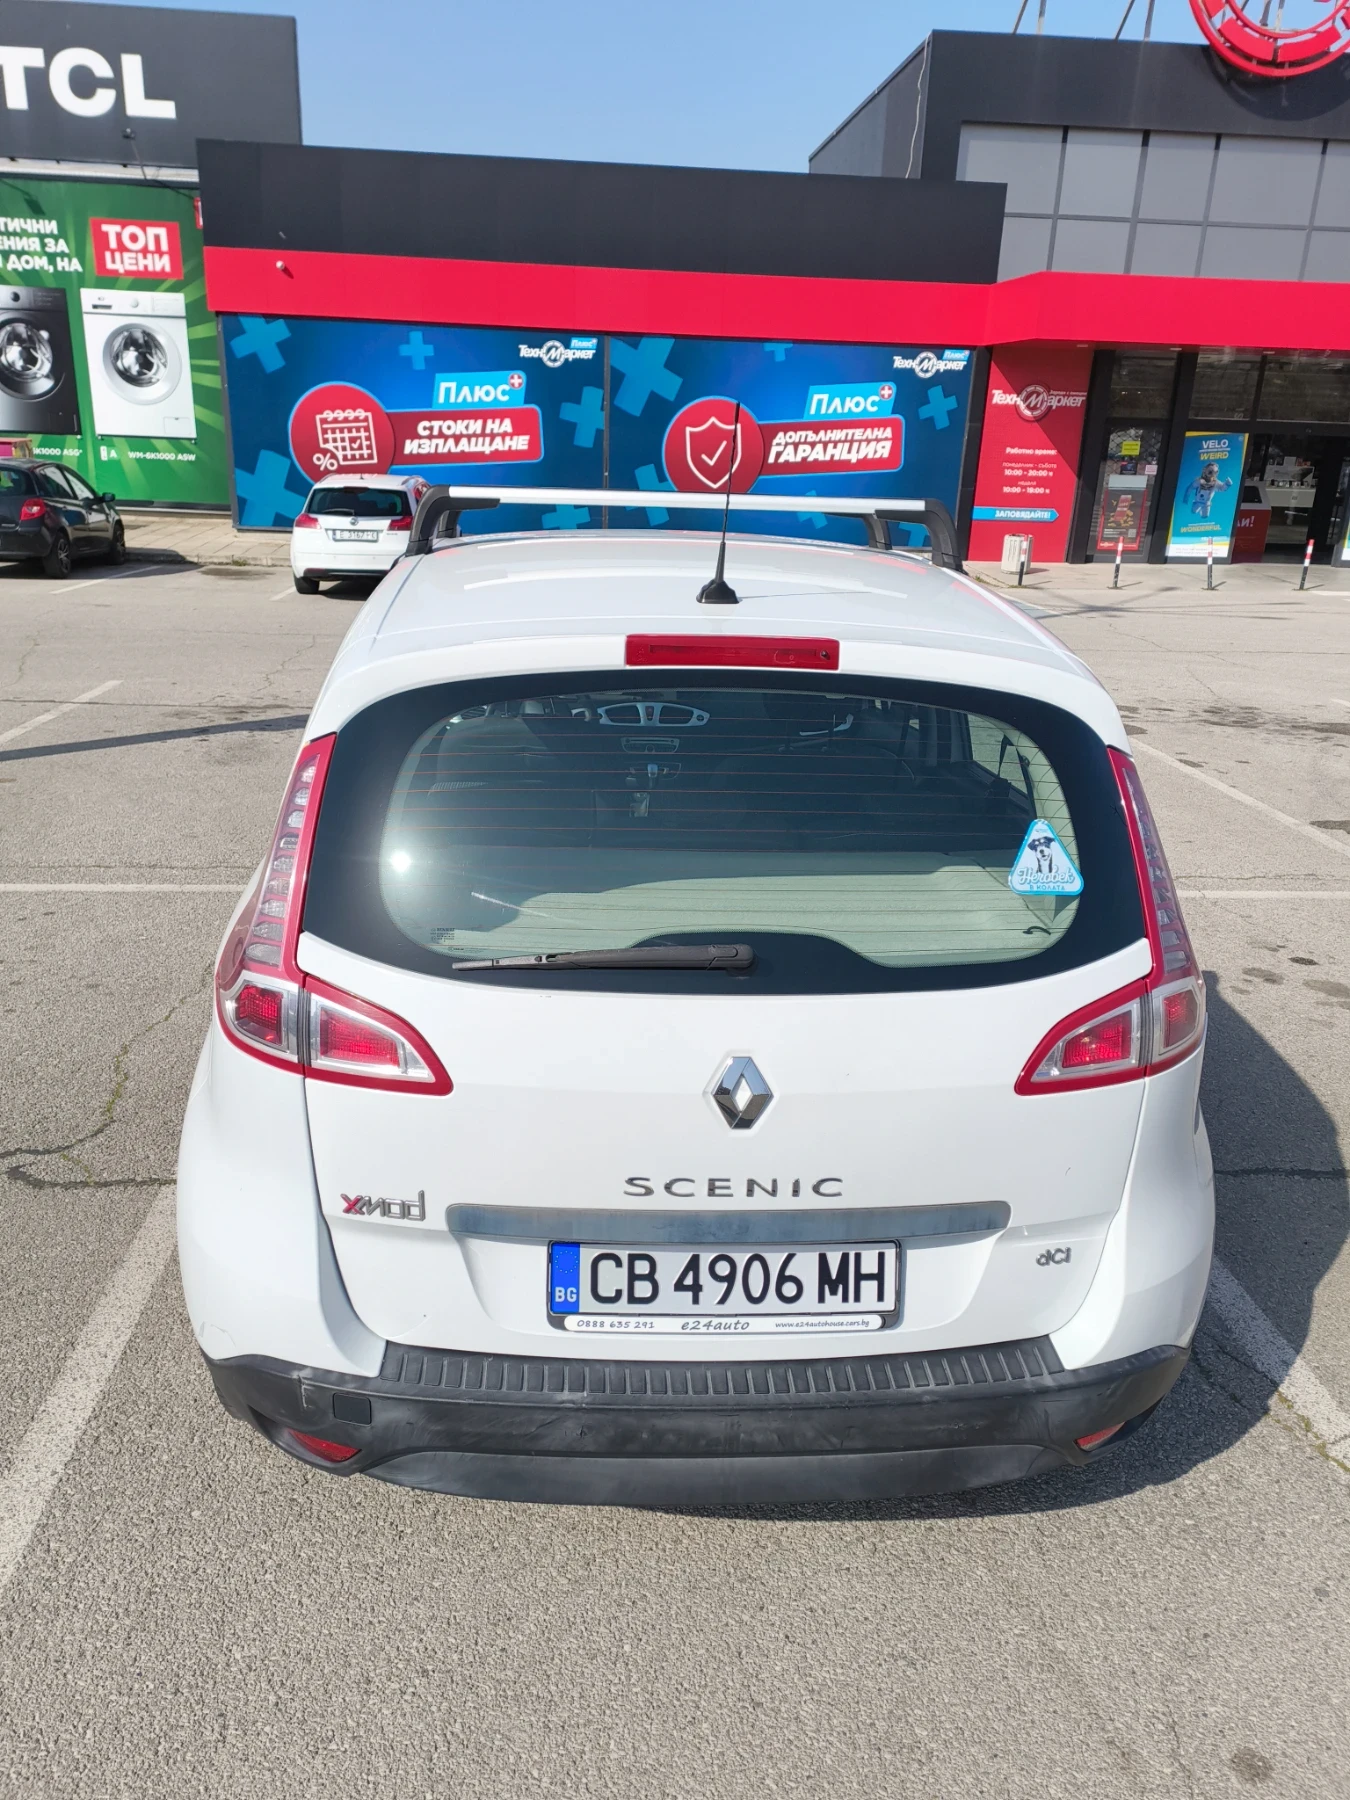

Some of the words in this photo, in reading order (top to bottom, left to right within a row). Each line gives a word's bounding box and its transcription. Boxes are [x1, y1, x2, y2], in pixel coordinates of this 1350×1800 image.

[0, 46, 176, 119] TCL
[44, 238, 70, 253] ЗА
[101, 224, 169, 252] ТОП
[6, 253, 54, 273] ДОМ,
[56, 257, 83, 272] НА
[104, 251, 171, 274] ЦЕНИ
[438, 381, 510, 404] Плюс
[809, 394, 880, 415] Плюс
[417, 419, 483, 436] СТОКИ
[486, 418, 513, 434] НА
[772, 427, 892, 446] ДОПЪЛНИТЕЛНА
[403, 434, 530, 455] ИЗПЛАЩАНЕ
[767, 441, 892, 464] ГАРАНЦИЯ
[1006, 447, 1034, 455] Работно
[1202, 439, 1229, 449] VELO
[1200, 452, 1229, 460] WEIRD
[995, 510, 1051, 519] ЗАПОВЯДАЙТЕ!
[623, 1177, 844, 1198] SCENIC
[590, 1252, 659, 1305] CB
[673, 1252, 804, 1305] 4906
[817, 1251, 886, 1304] MH
[554, 1287, 577, 1303] BG
[577, 1319, 605, 1328] 0888
[609, 1320, 631, 1329] 635
[633, 1321, 655, 1329] 291
[681, 1319, 749, 1331] e24auto
[775, 1318, 870, 1328] www.e24autohouse.cars.bg
